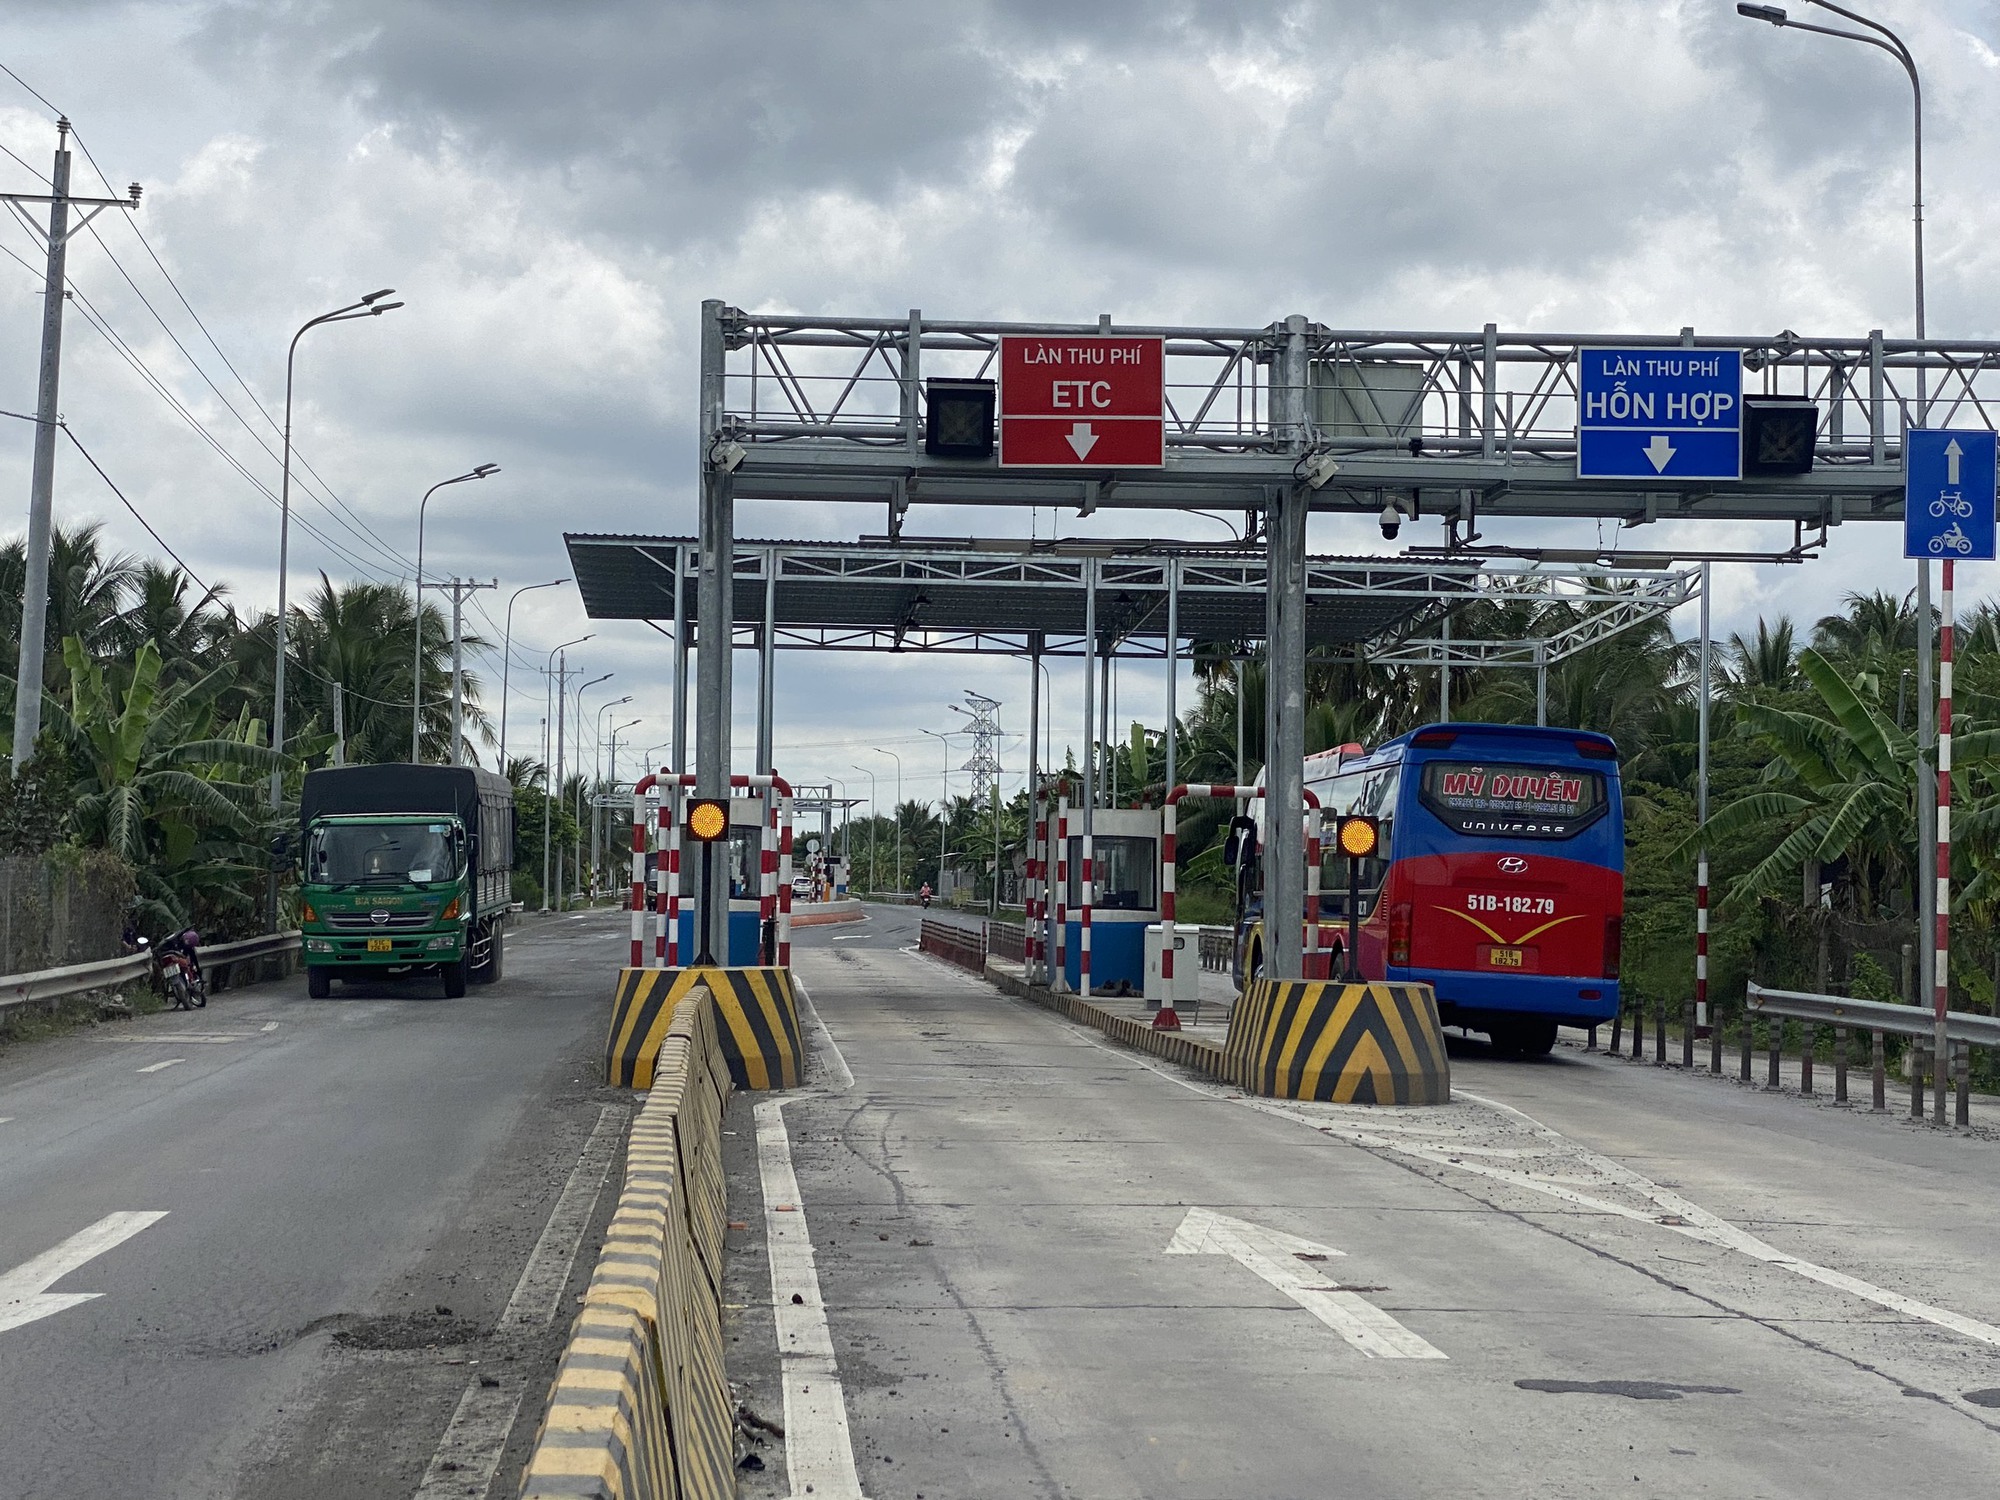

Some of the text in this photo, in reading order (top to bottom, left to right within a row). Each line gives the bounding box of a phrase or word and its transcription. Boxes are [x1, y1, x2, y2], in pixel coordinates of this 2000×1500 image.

[1023, 343, 1142, 364] LÀN THU PHÍ
[1602, 355, 1720, 377] LÀN THU PHÍ
[1052, 380, 1111, 408] ETC
[1586, 381, 1734, 426] HỖN HỢP
[1443, 767, 1582, 802] MỸ DUYÊN
[1462, 821, 1565, 832] UNIVERSE
[1467, 895, 1554, 914] 51B-182.79
[1494, 958, 1518, 966] 182.79
